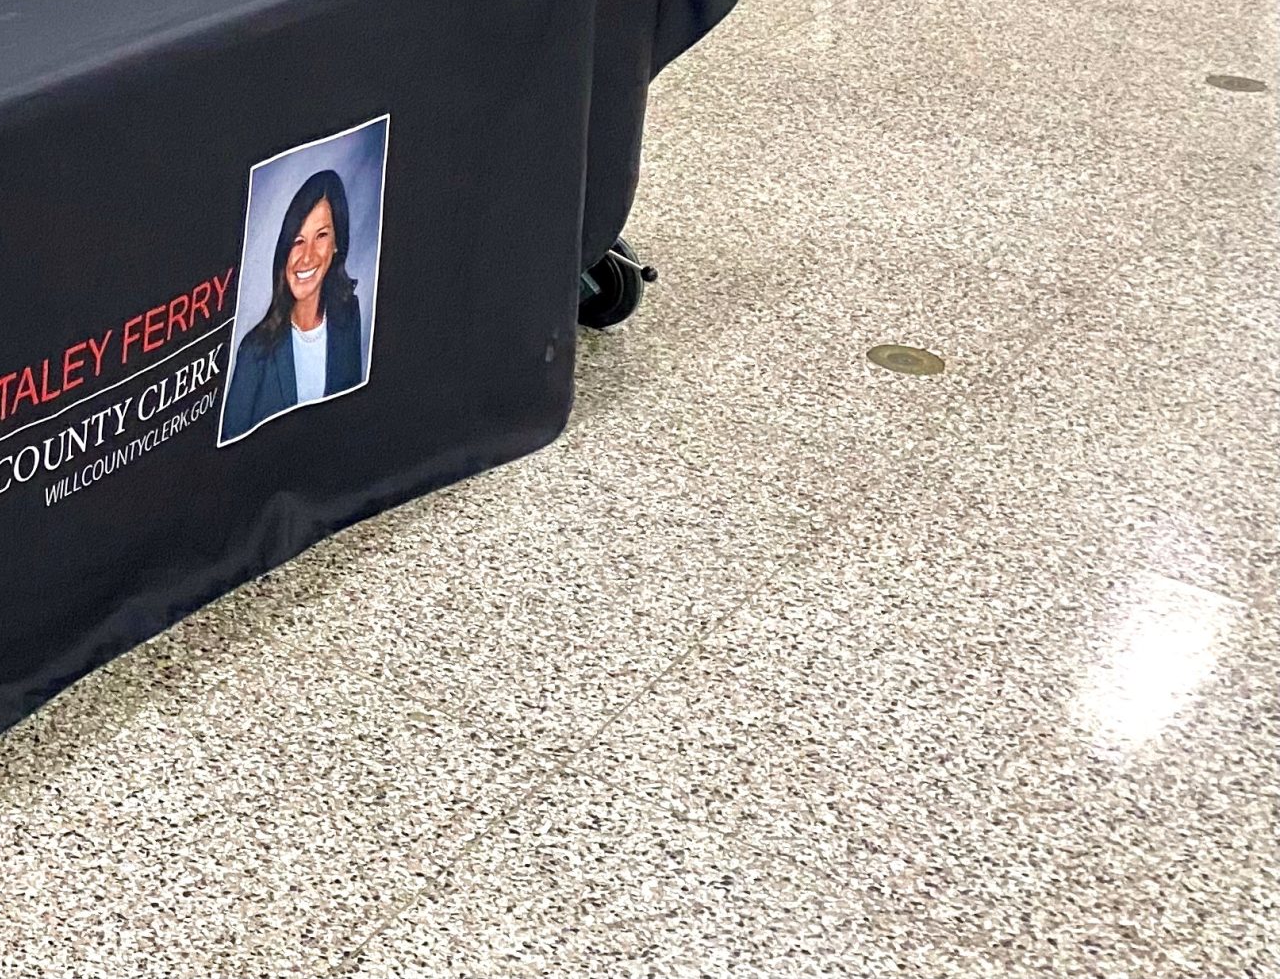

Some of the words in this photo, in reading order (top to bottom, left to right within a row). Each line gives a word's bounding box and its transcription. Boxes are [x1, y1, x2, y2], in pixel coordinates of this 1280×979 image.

[121, 267, 234, 365] FERRY
[136, 342, 224, 422] CLERK
[43, 386, 219, 508] WILLCOUNTYCLERK.GOV
